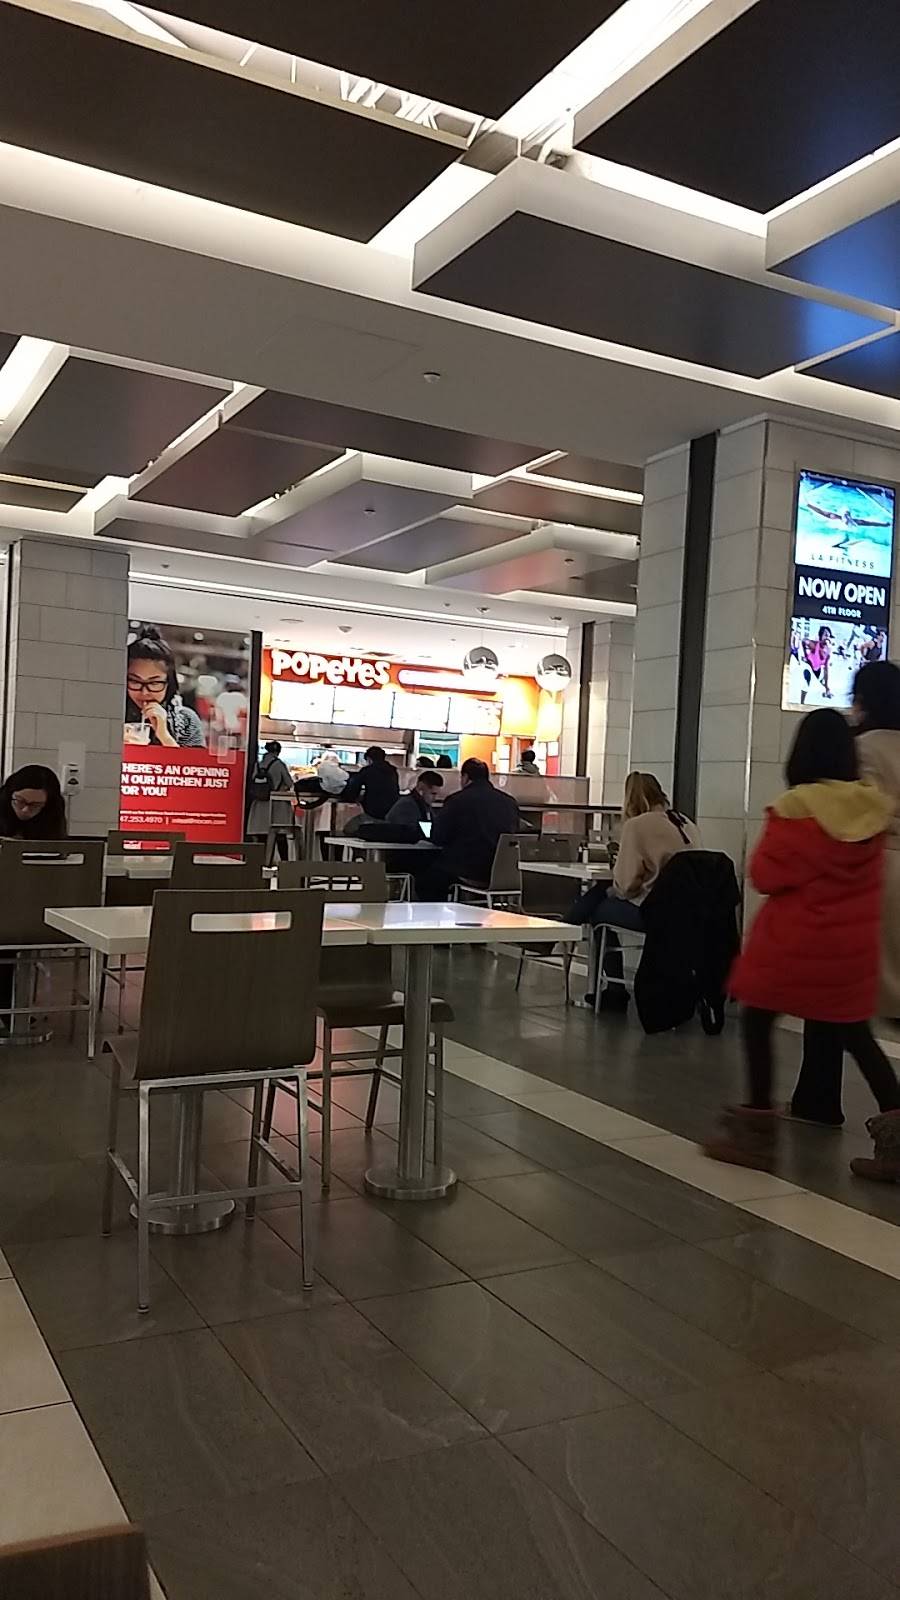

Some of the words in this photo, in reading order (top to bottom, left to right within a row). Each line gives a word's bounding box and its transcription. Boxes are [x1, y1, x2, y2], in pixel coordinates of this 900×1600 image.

[829, 555, 875, 569] FITNESS
[798, 575, 842, 601] NOW
[843, 582, 886, 607] OPEN
[822, 605, 837, 616] 4TH
[838, 607, 862, 619] FLOOR
[164, 764, 181, 775] AN
[182, 766, 230, 778] OPENING
[130, 774, 156, 785] OUR
[156, 776, 202, 788] KITCHEN
[203, 778, 229, 789] JUST
[141, 786, 168, 797] YOU!
